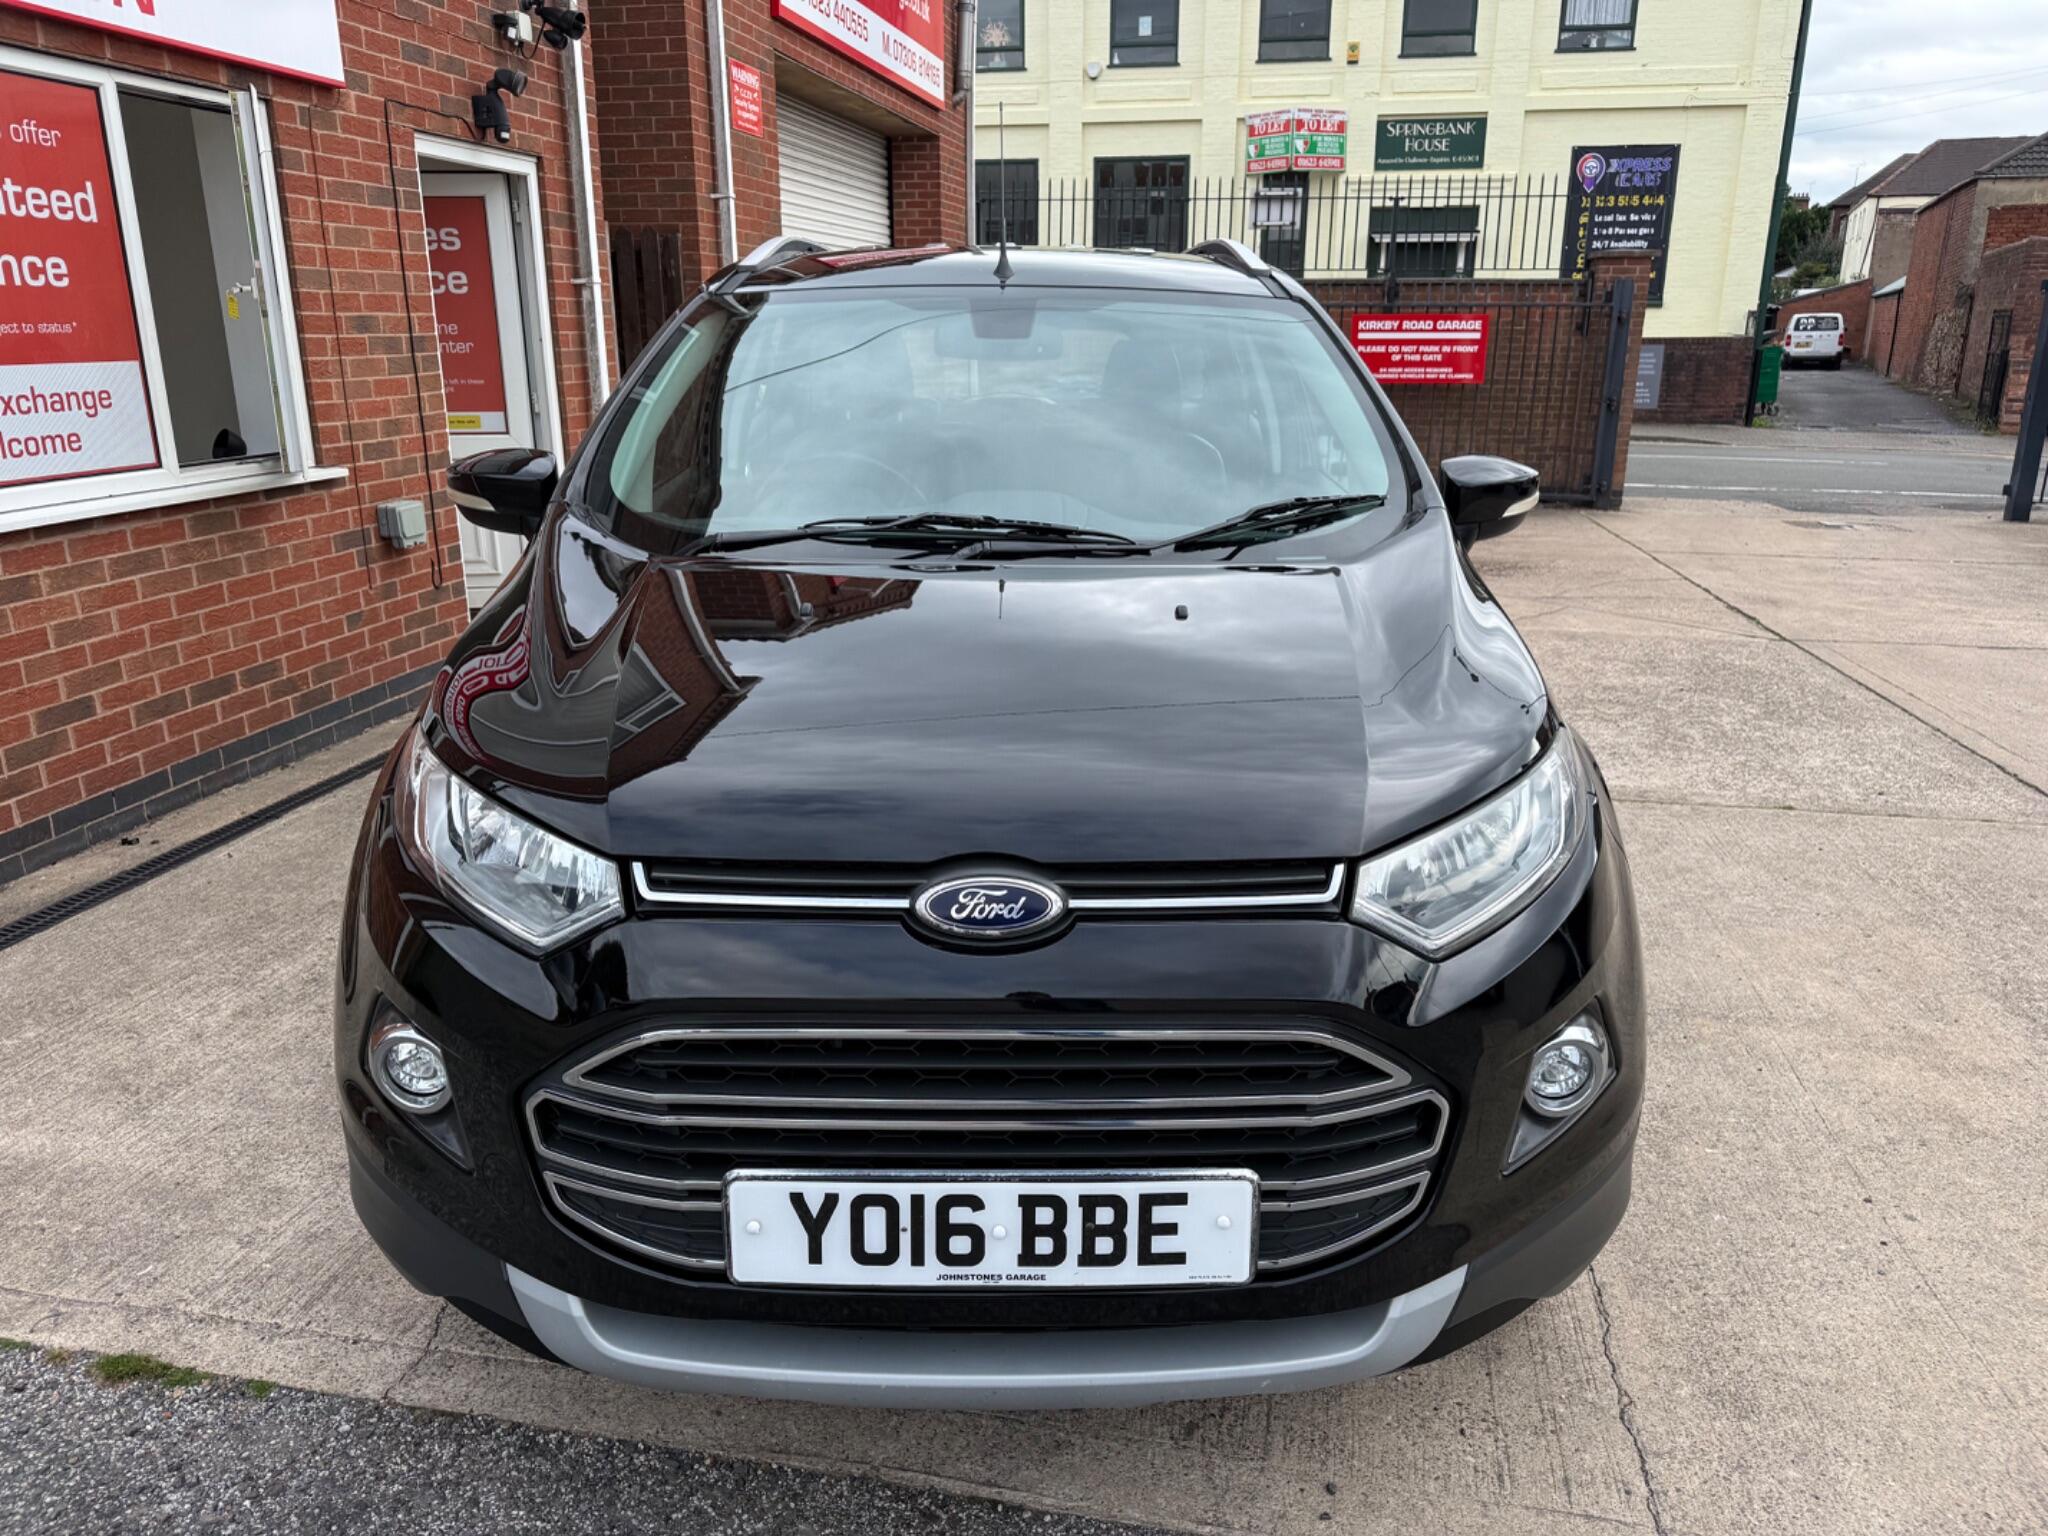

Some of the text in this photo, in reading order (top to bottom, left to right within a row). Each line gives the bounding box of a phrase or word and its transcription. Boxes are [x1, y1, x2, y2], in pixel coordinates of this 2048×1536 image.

[9, 118, 61, 148] offer
[1386, 121, 1477, 137] SPRINGBANK
[1404, 138, 1450, 152] HOUSE
[0, 177, 99, 223] teed
[1357, 320, 1483, 331] KIRKBY ROAD GARAGE
[1357, 345, 1479, 353] PLEASE DO NOT PARK IN FRONT
[950, 888, 1027, 920] Ford
[789, 1192, 1188, 1267] YO16 BBE
[936, 1273, 1047, 1281] JOHNSTONES GARAGE
